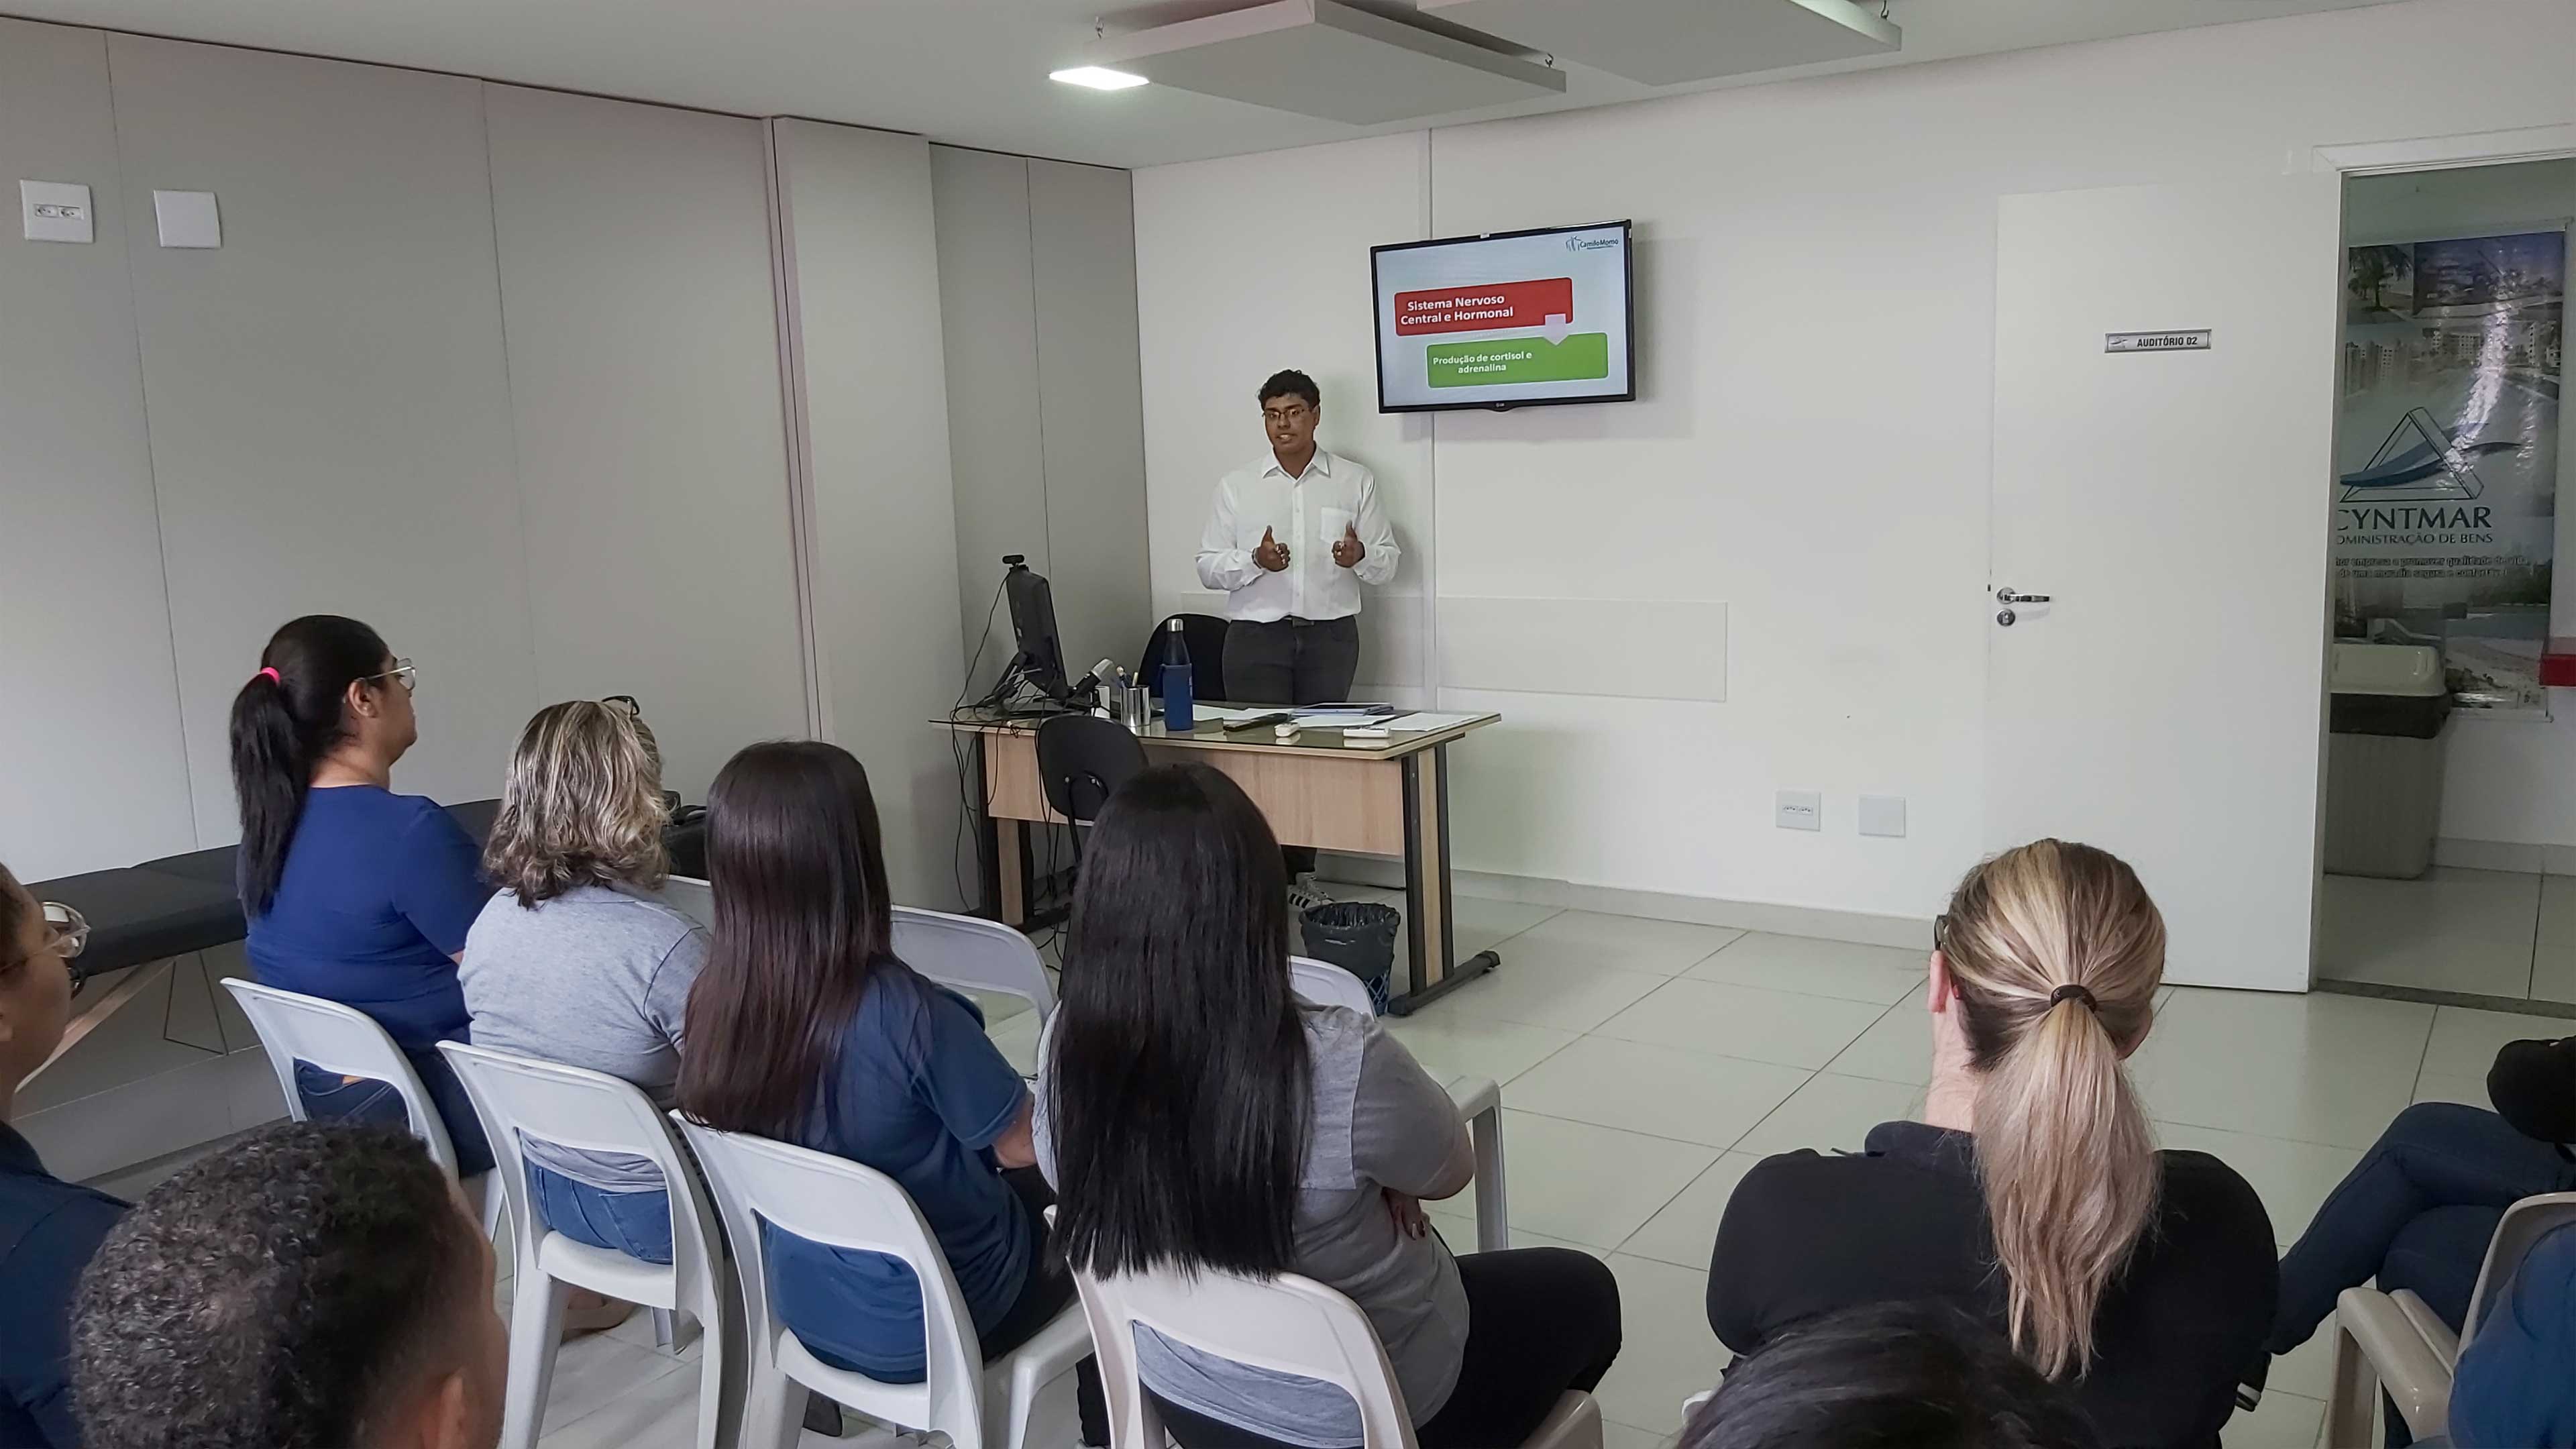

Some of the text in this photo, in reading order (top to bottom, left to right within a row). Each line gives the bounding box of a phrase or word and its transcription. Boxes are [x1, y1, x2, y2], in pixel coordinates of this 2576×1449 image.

[1407, 295, 1505, 311] Sistema Nervoso
[1401, 307, 1513, 325] Central e Hormonal
[2137, 335, 2198, 347] AUDITÓRIO 02
[1433, 356, 1475, 365] Produção
[1477, 354, 1489, 362] de
[1490, 351, 1524, 361] cortisol
[1458, 364, 1507, 374] adrenalina
[2439, 534, 2456, 543] DE
[2461, 533, 2493, 543] BENS
